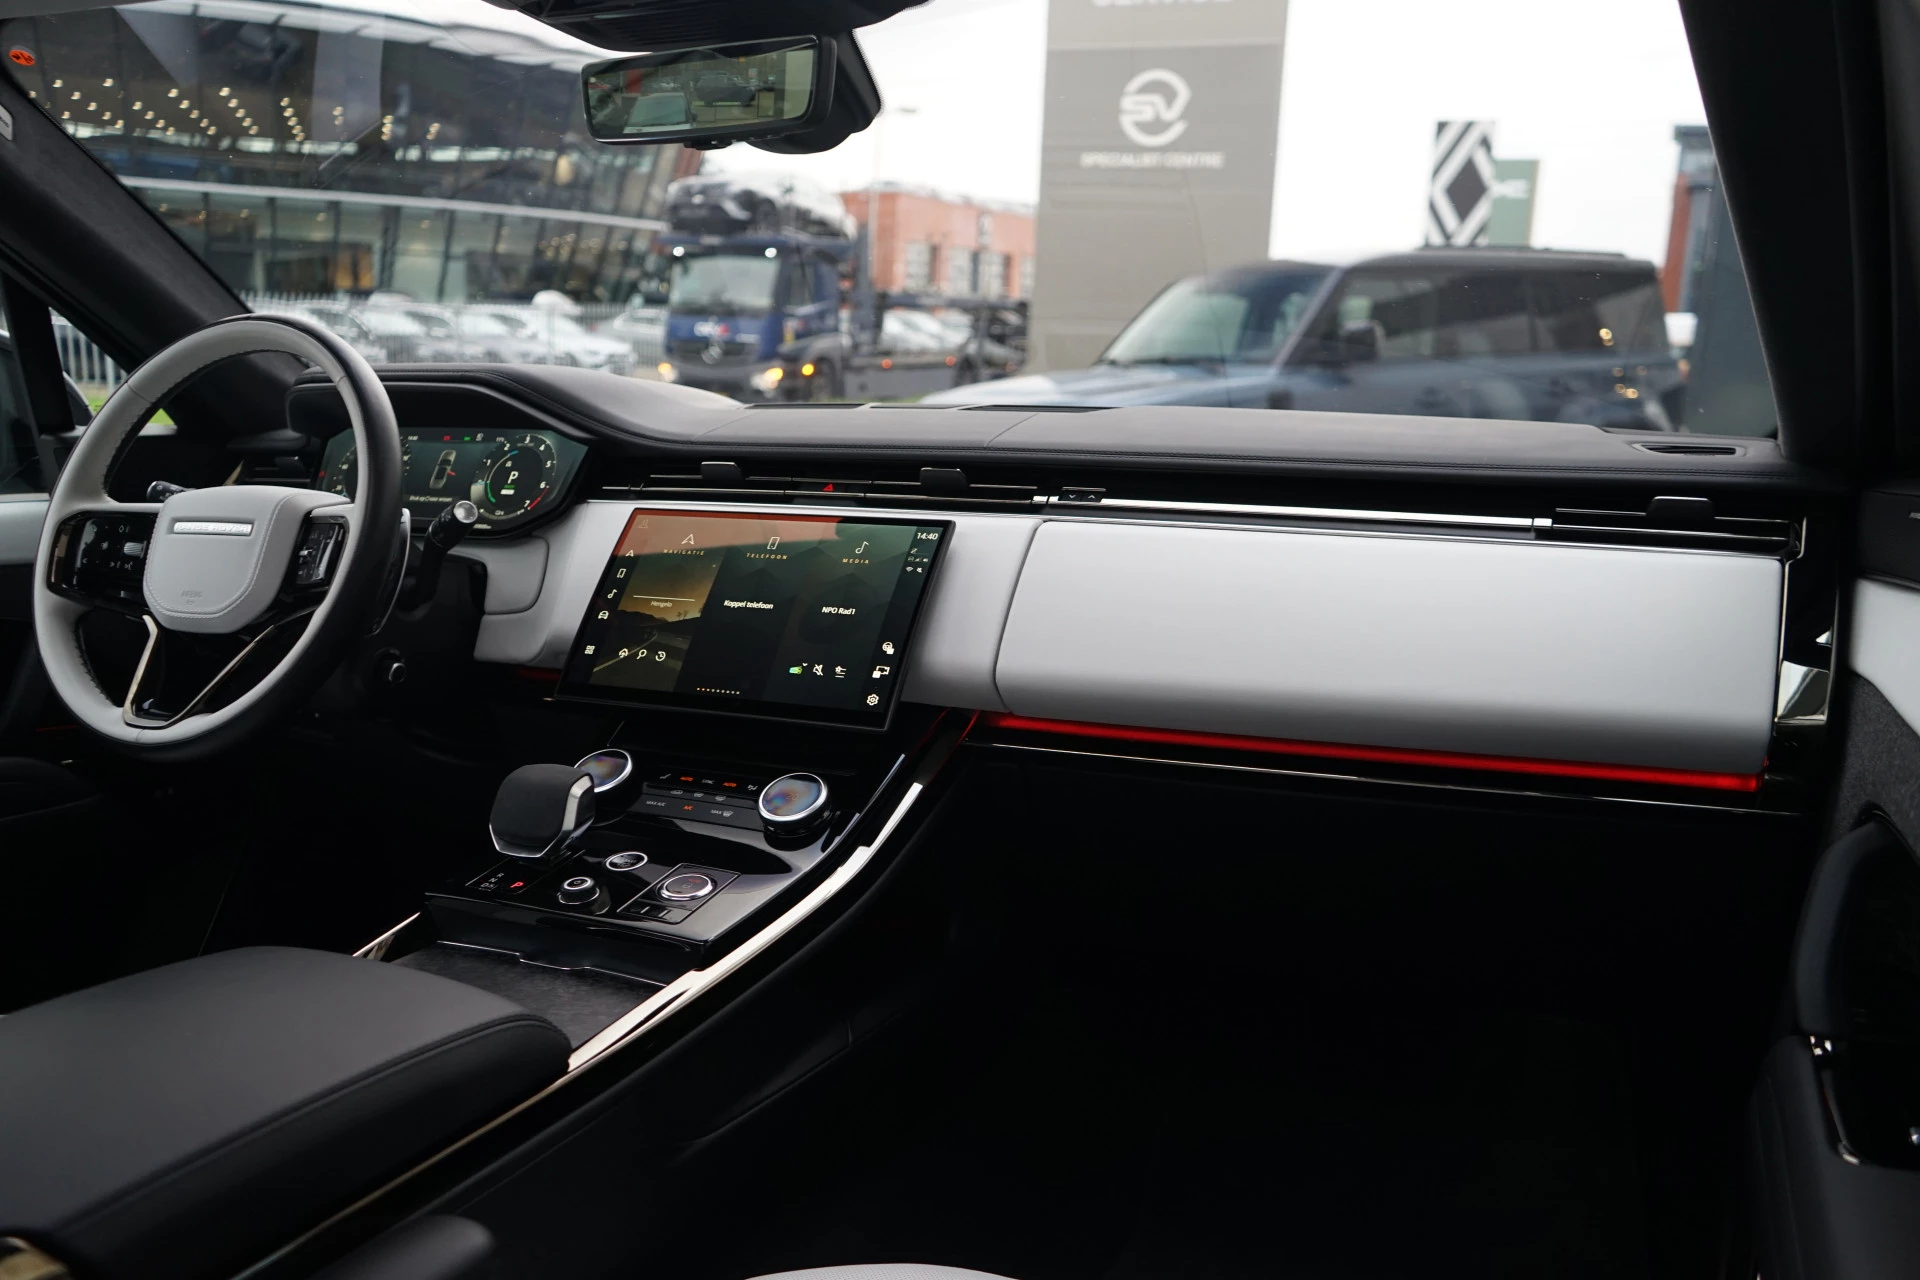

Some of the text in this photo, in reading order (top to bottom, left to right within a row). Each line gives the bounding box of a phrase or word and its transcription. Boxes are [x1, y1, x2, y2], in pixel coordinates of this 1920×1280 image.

[1164, 152, 1226, 168] CENTRE
[507, 470, 519, 484] P
[916, 532, 939, 541] 14:40
[746, 552, 788, 560] TELEFOON
[723, 599, 774, 610] Koppel telefoon
[821, 606, 856, 615] NPO Rad1
[509, 881, 524, 889] P
